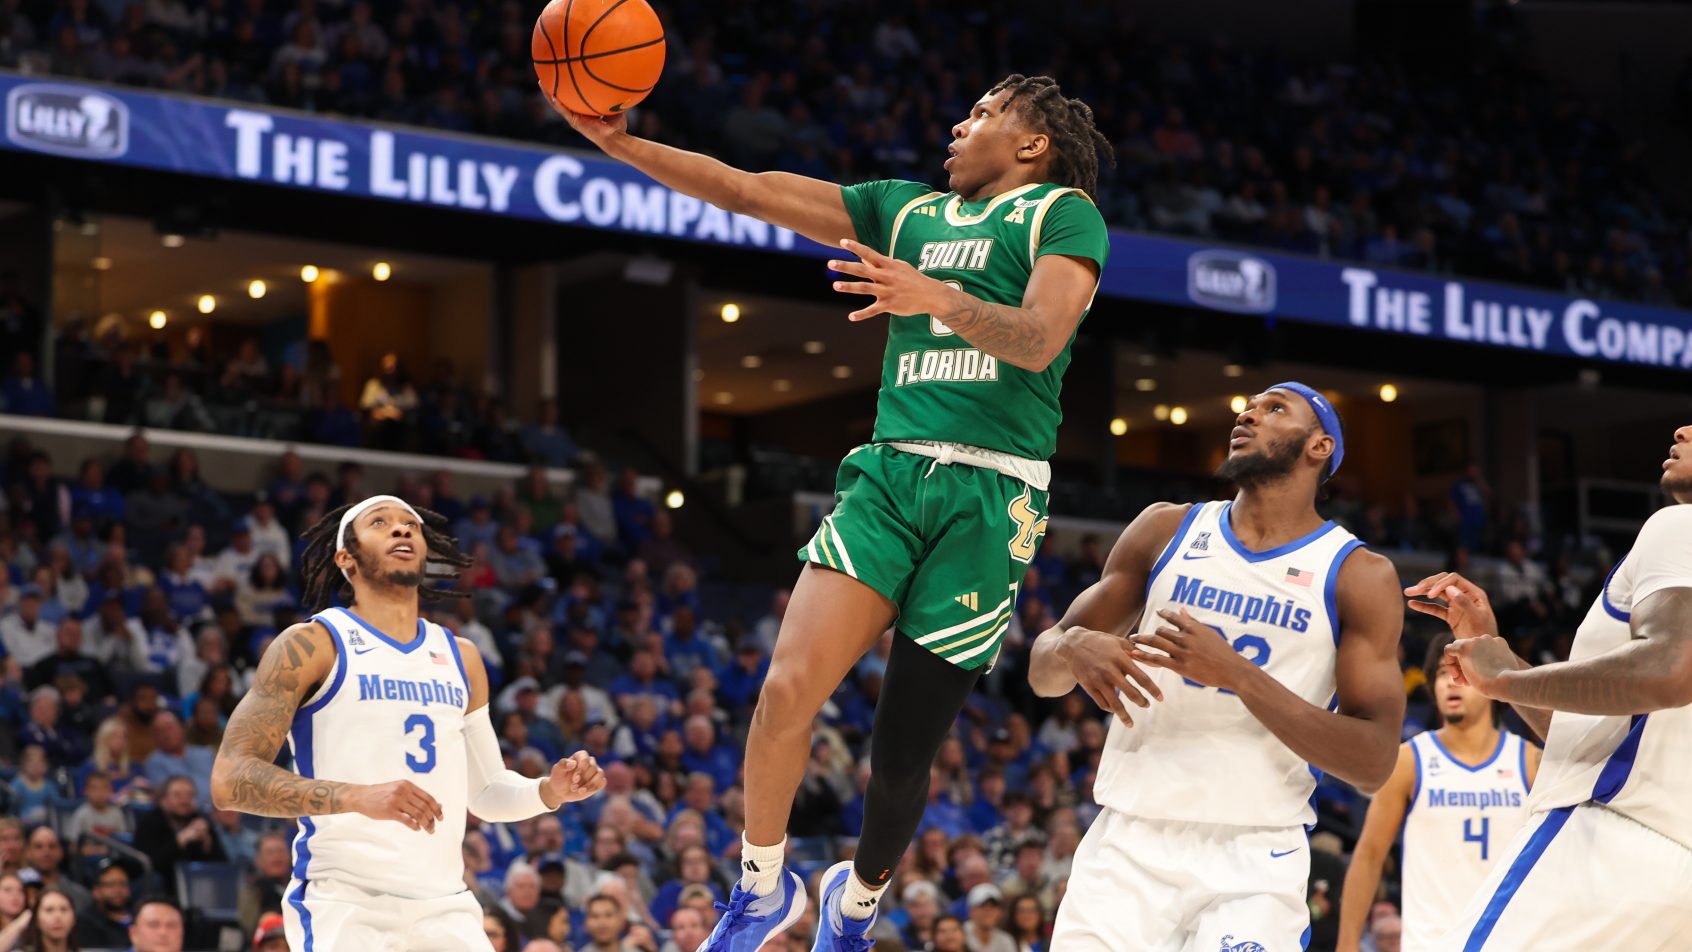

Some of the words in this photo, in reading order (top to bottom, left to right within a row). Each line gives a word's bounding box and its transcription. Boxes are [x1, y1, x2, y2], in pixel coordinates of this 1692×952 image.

[918, 238, 995, 273] SOUTH
[895, 347, 999, 388] FLORIDA
[1169, 574, 1312, 634] Memphis
[357, 674, 463, 709] Memphis
[404, 714, 436, 774] 3
[1428, 788, 1521, 811] Memphis
[1463, 817, 1489, 861] 4
